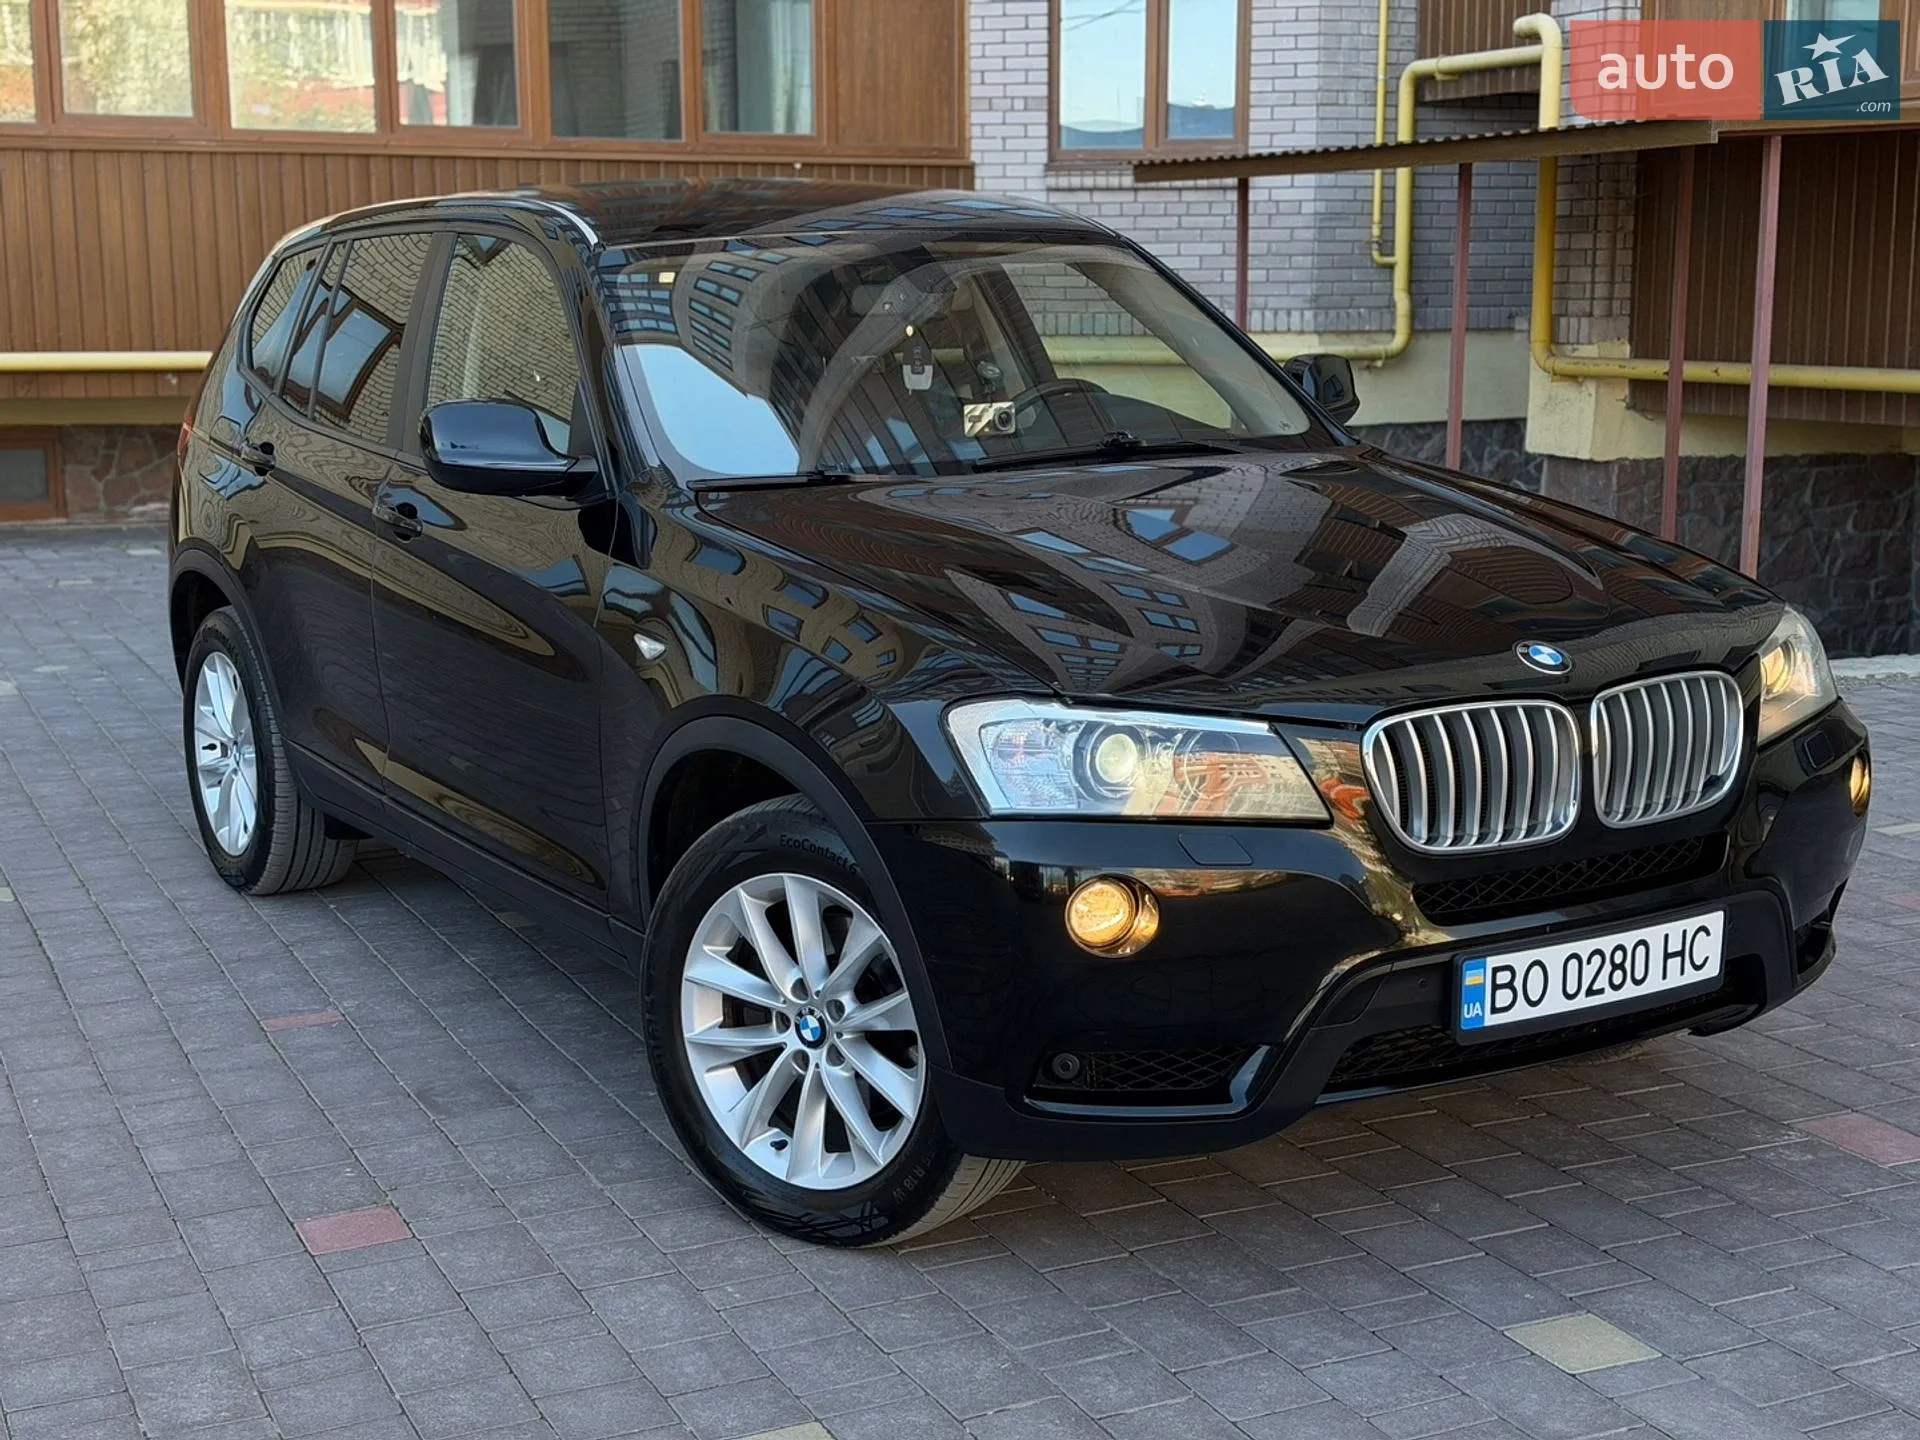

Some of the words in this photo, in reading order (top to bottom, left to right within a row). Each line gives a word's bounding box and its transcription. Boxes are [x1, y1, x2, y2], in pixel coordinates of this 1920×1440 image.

[779, 834, 849, 869] EcoContact
[1490, 959, 1549, 1015] BO
[1562, 938, 1650, 1001] 0280
[1661, 925, 1711, 981] HC
[1464, 1003, 1482, 1019] UA
